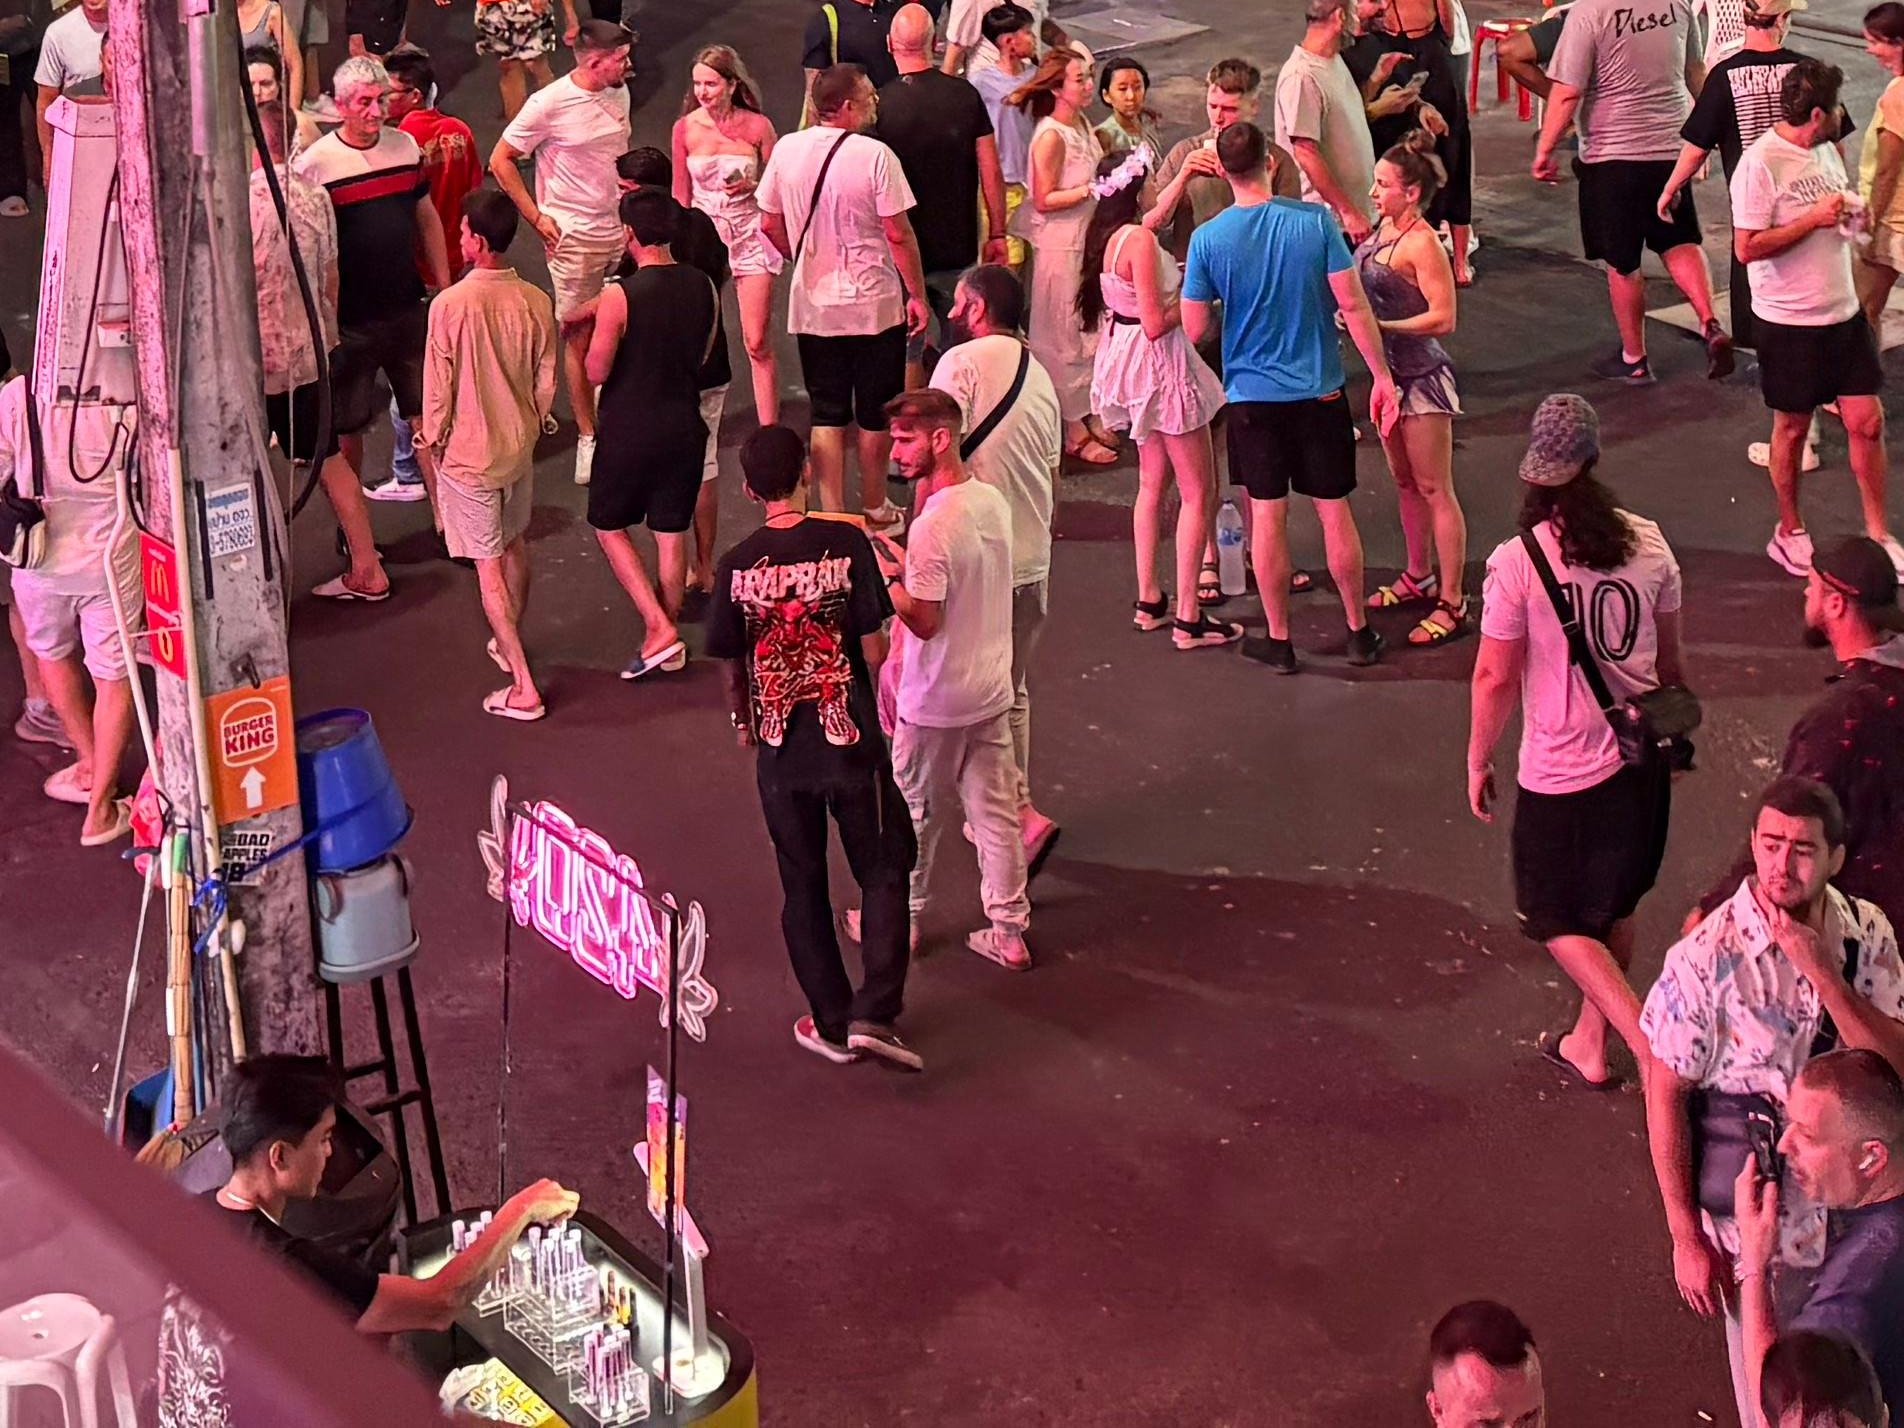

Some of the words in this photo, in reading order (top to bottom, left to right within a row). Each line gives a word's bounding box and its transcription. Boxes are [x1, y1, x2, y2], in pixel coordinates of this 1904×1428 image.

[1614, 3, 1678, 39] Diesel
[223, 715, 275, 738] BURGER
[224, 729, 277, 755] KING
